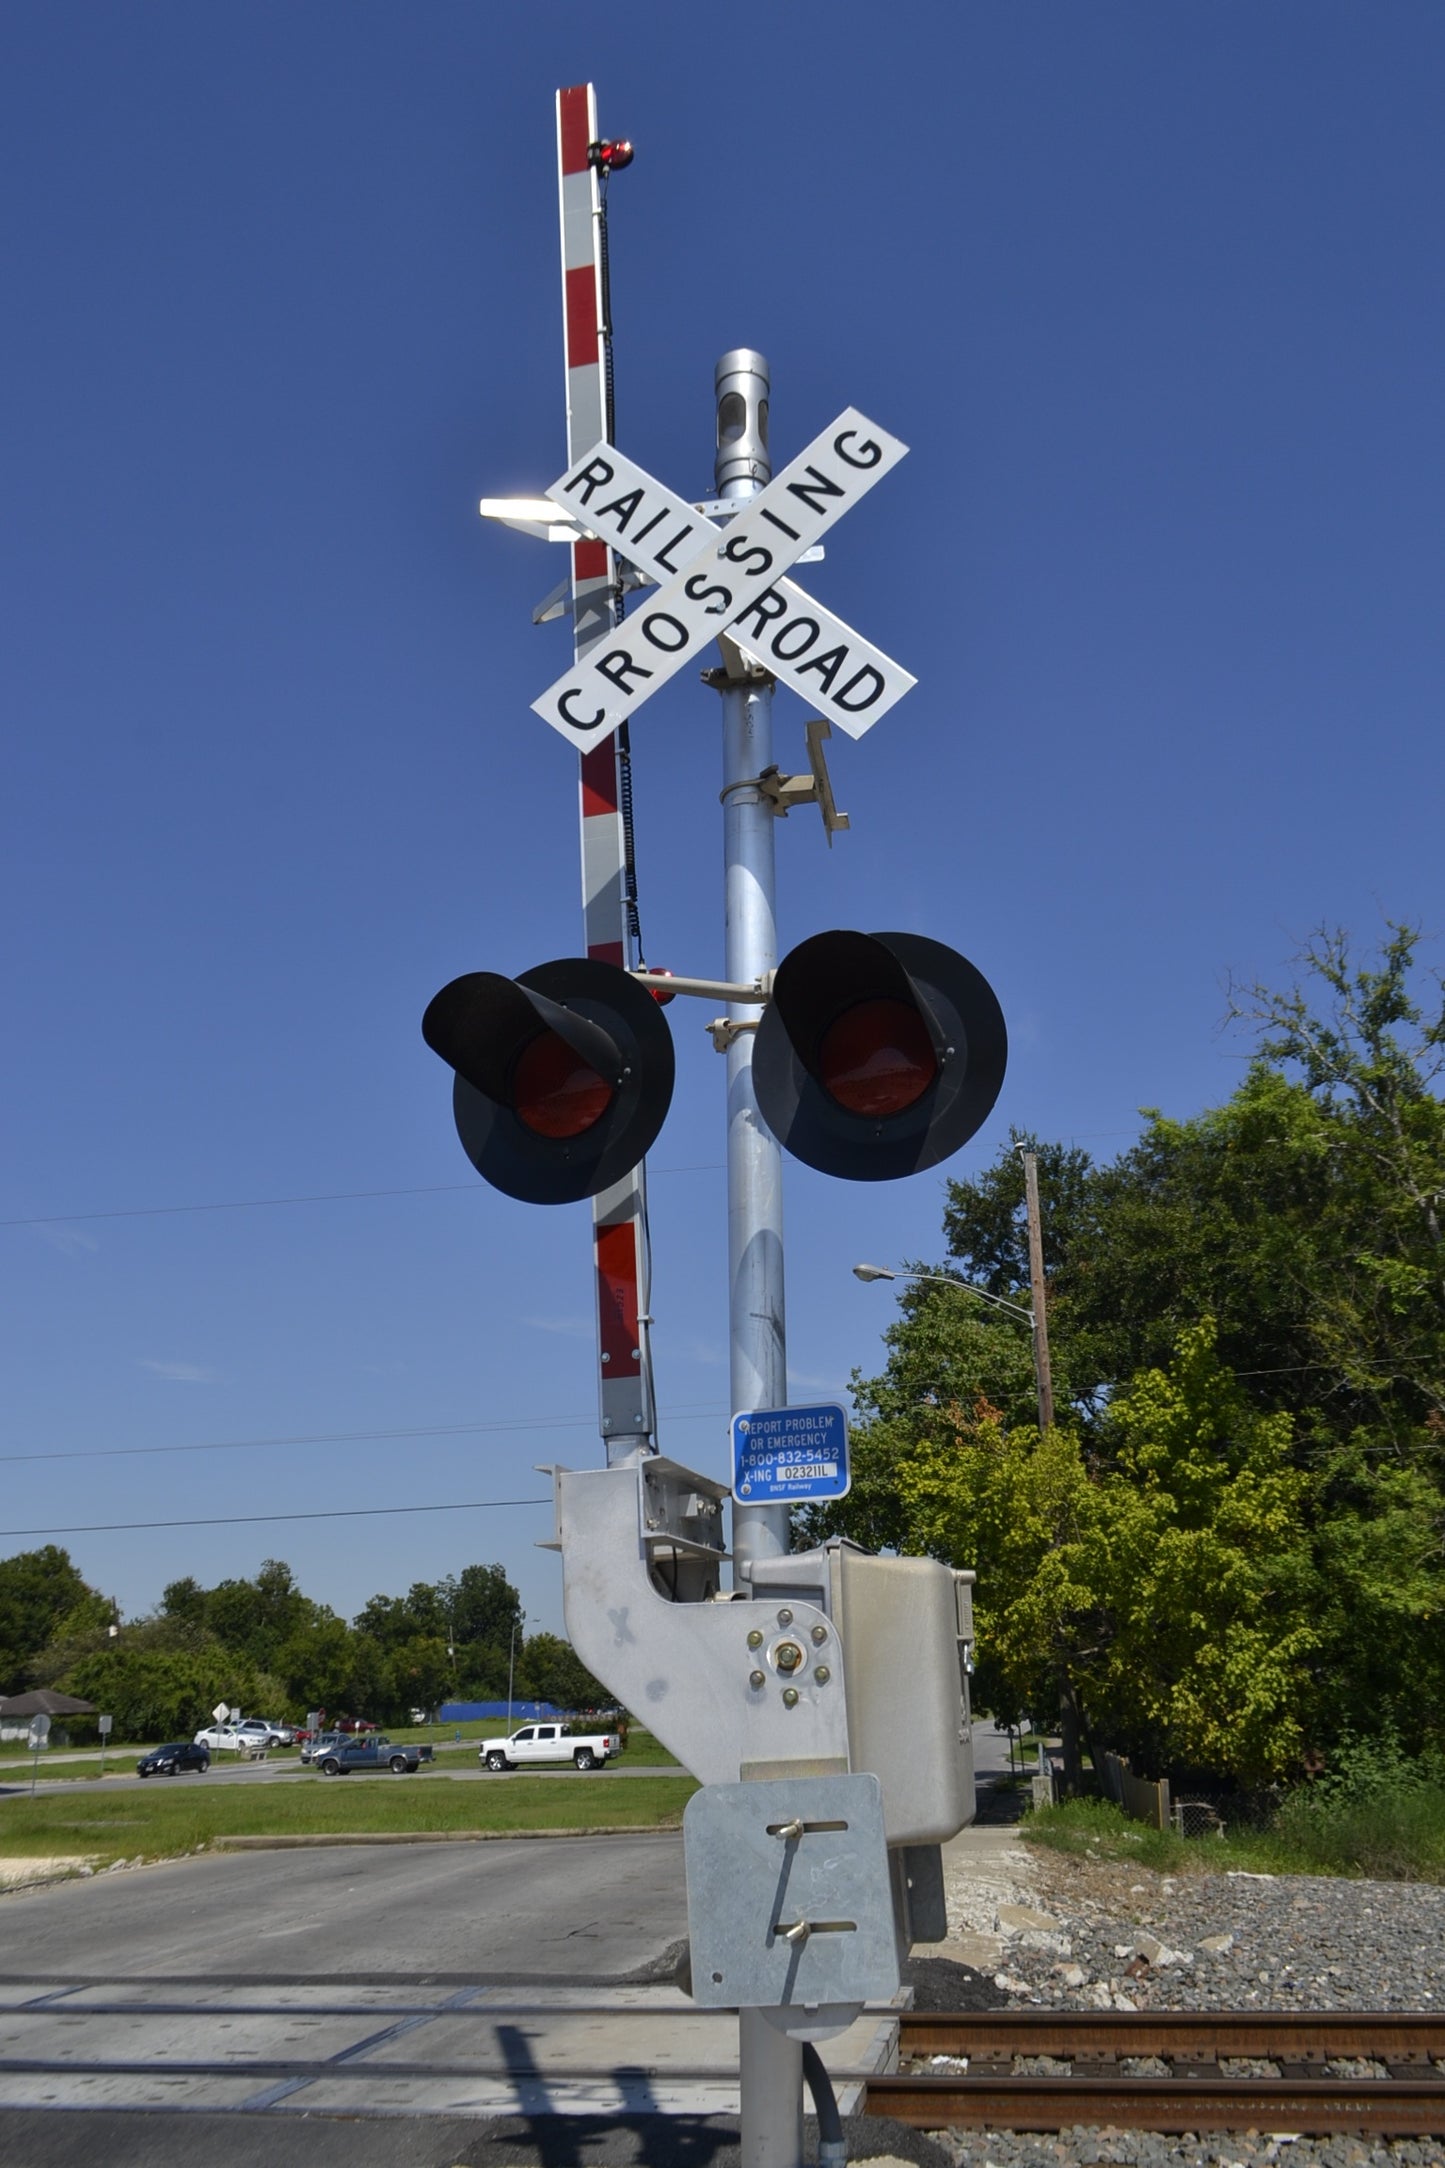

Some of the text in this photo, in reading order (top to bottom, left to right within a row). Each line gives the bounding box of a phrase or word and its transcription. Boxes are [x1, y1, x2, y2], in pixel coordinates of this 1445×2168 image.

[557, 430, 883, 731] CROSSING
[563, 456, 886, 713] RAIL ROAD
[785, 1416, 833, 1431] PROBLEM
[750, 1432, 828, 1451] OR EMERGENCY
[741, 1448, 840, 1468] 1-800-832-5452
[744, 1465, 829, 1483] X-ING 023211L
[770, 1483, 812, 1493] BNSF Railway
